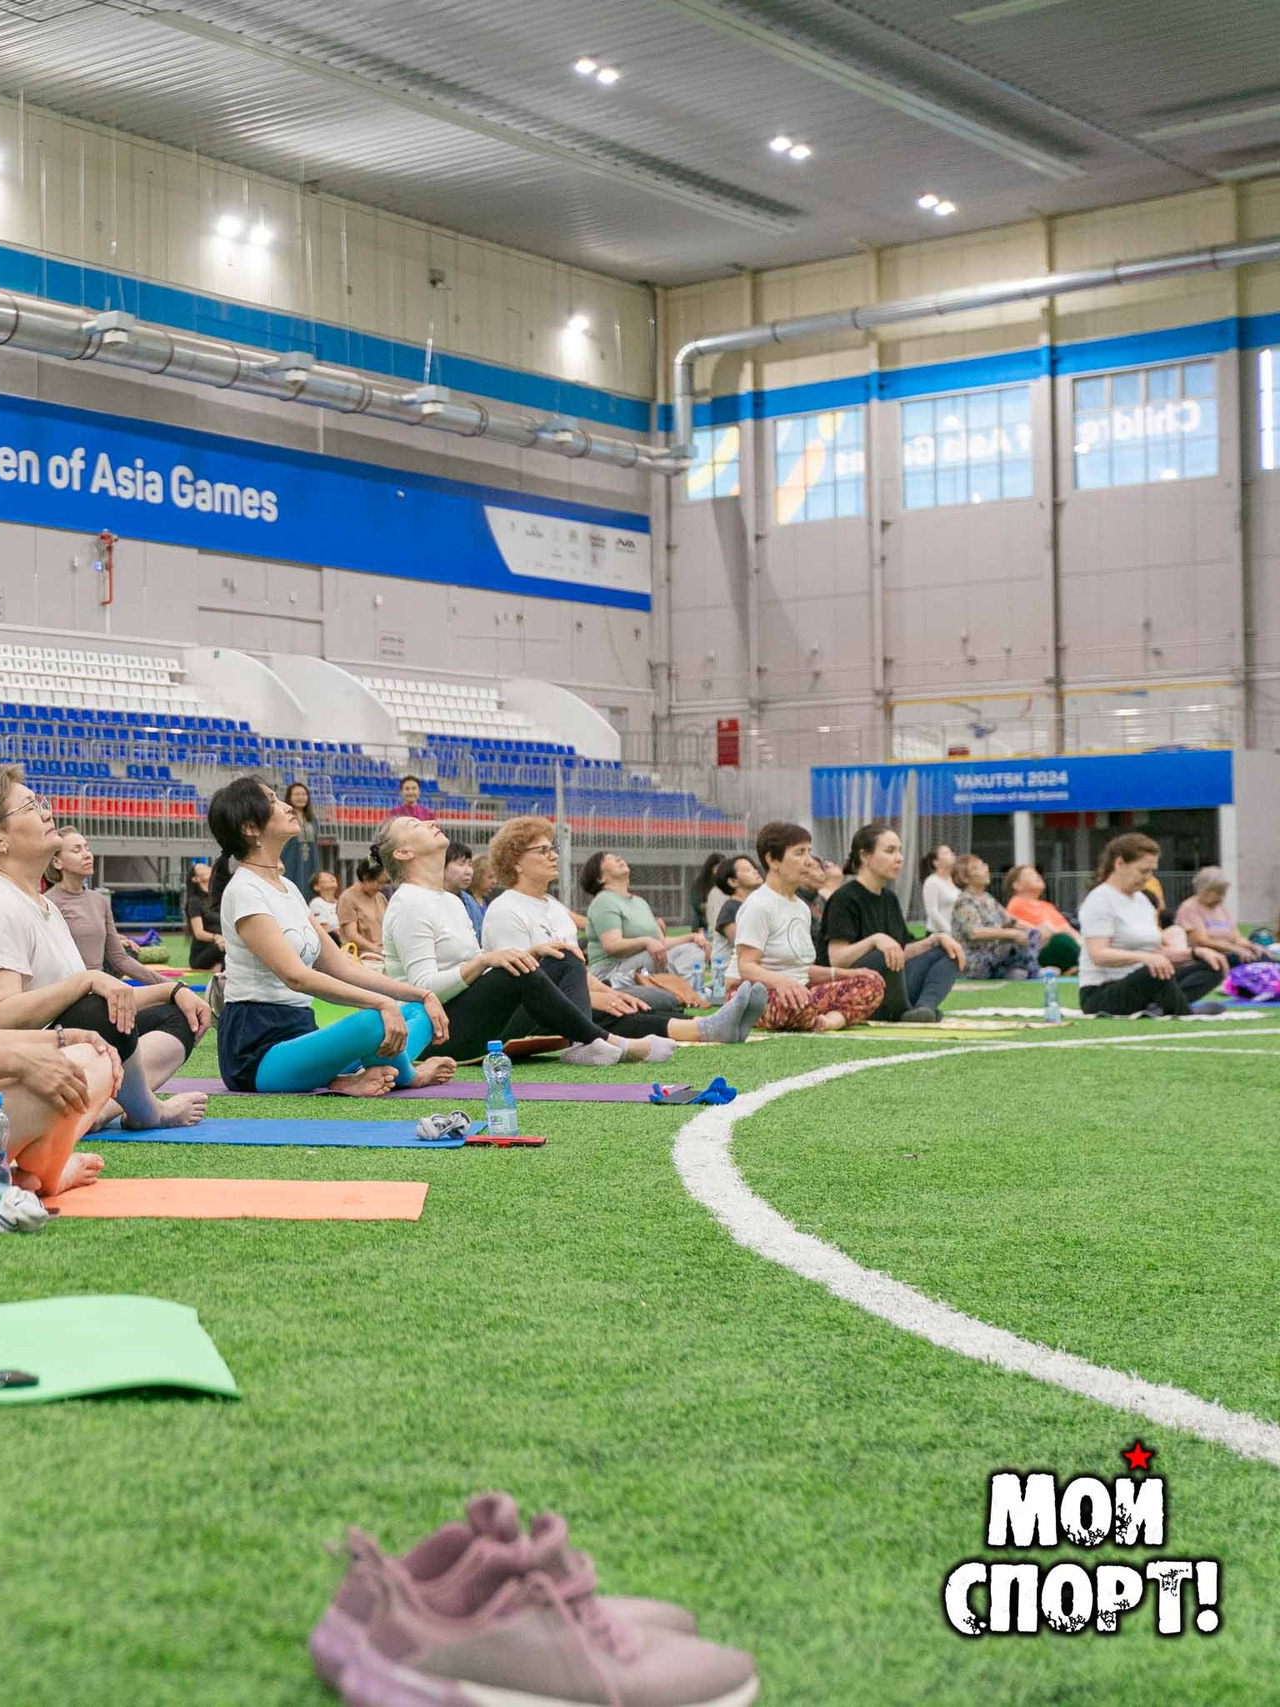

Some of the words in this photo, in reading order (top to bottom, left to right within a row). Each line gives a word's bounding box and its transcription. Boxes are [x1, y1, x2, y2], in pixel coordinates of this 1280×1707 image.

[47, 447, 86, 491] of
[90, 452, 164, 504] Asia
[170, 464, 280, 523] Games
[954, 773, 1024, 789] YAKUTSK
[1027, 770, 1068, 787] 2024
